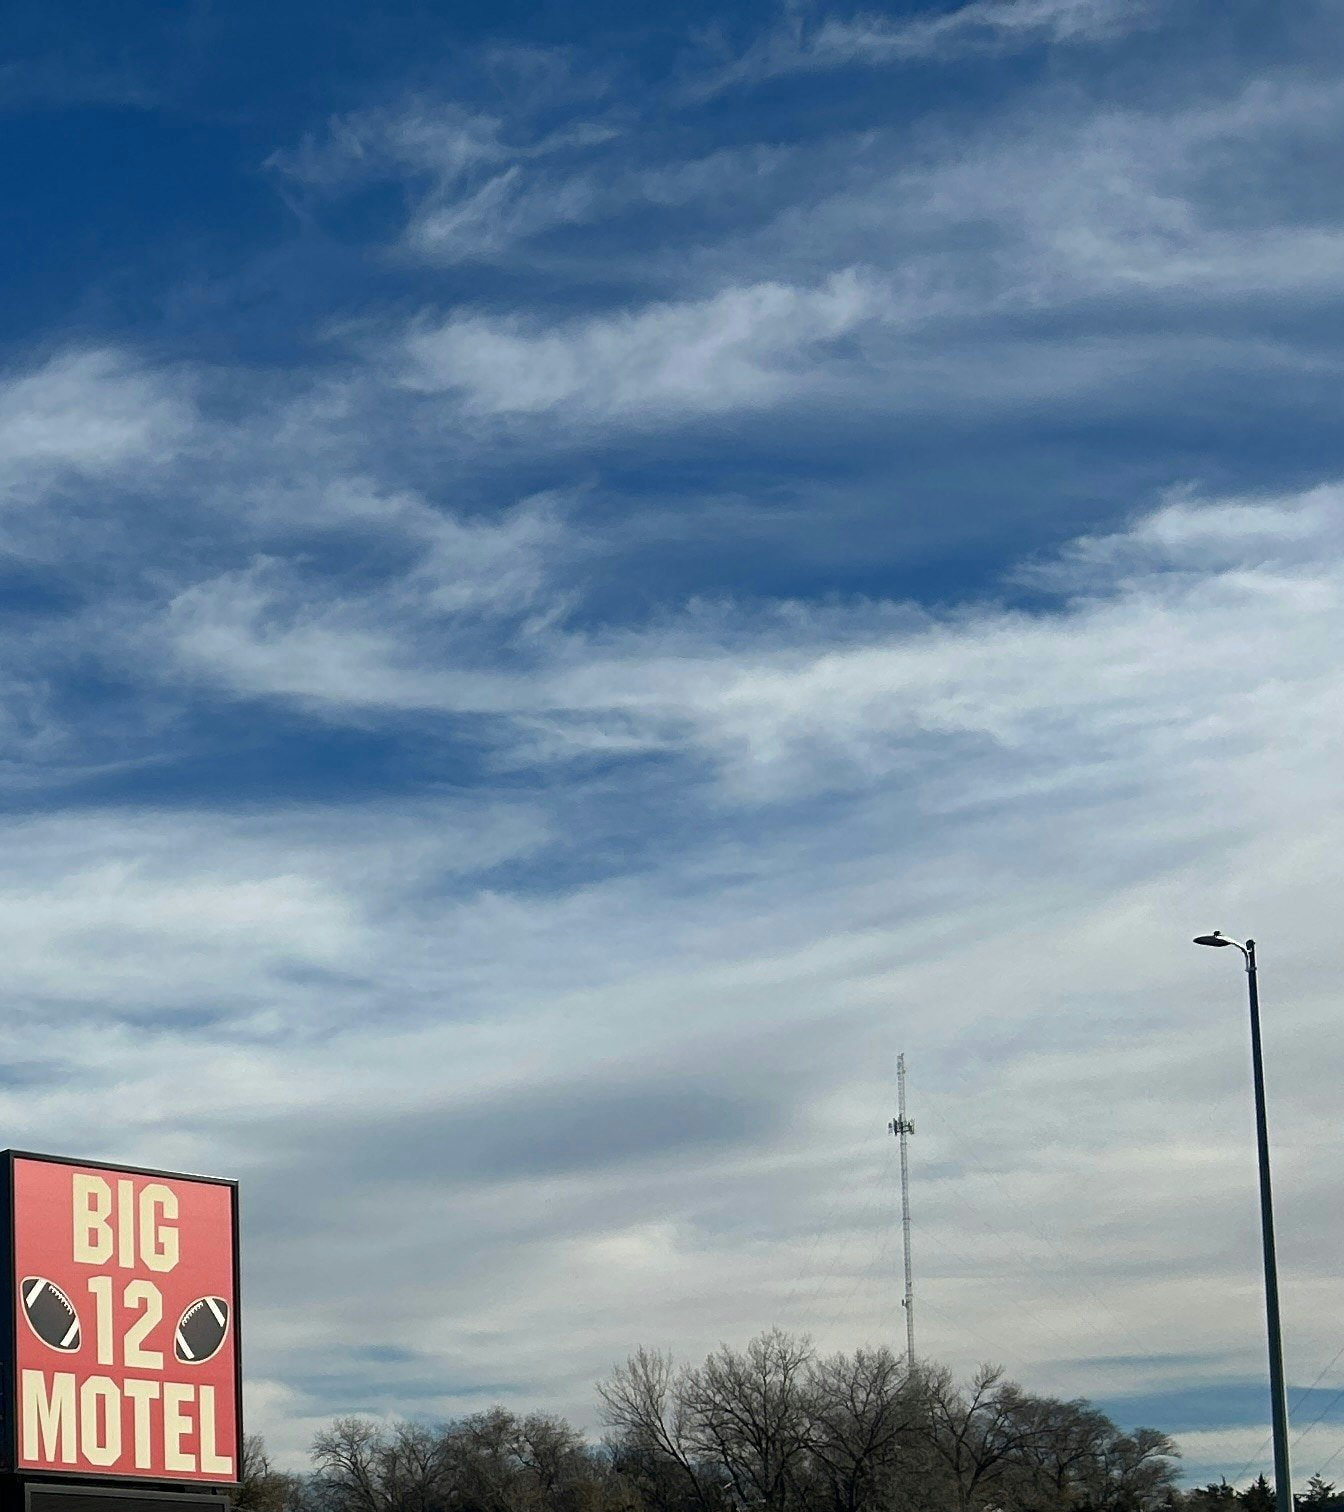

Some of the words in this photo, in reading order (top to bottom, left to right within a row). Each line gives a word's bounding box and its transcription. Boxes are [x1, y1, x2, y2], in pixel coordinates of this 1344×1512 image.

[72, 1173, 180, 1273] BIG
[87, 1275, 164, 1370] 12
[21, 1368, 233, 1475] MOTEL
